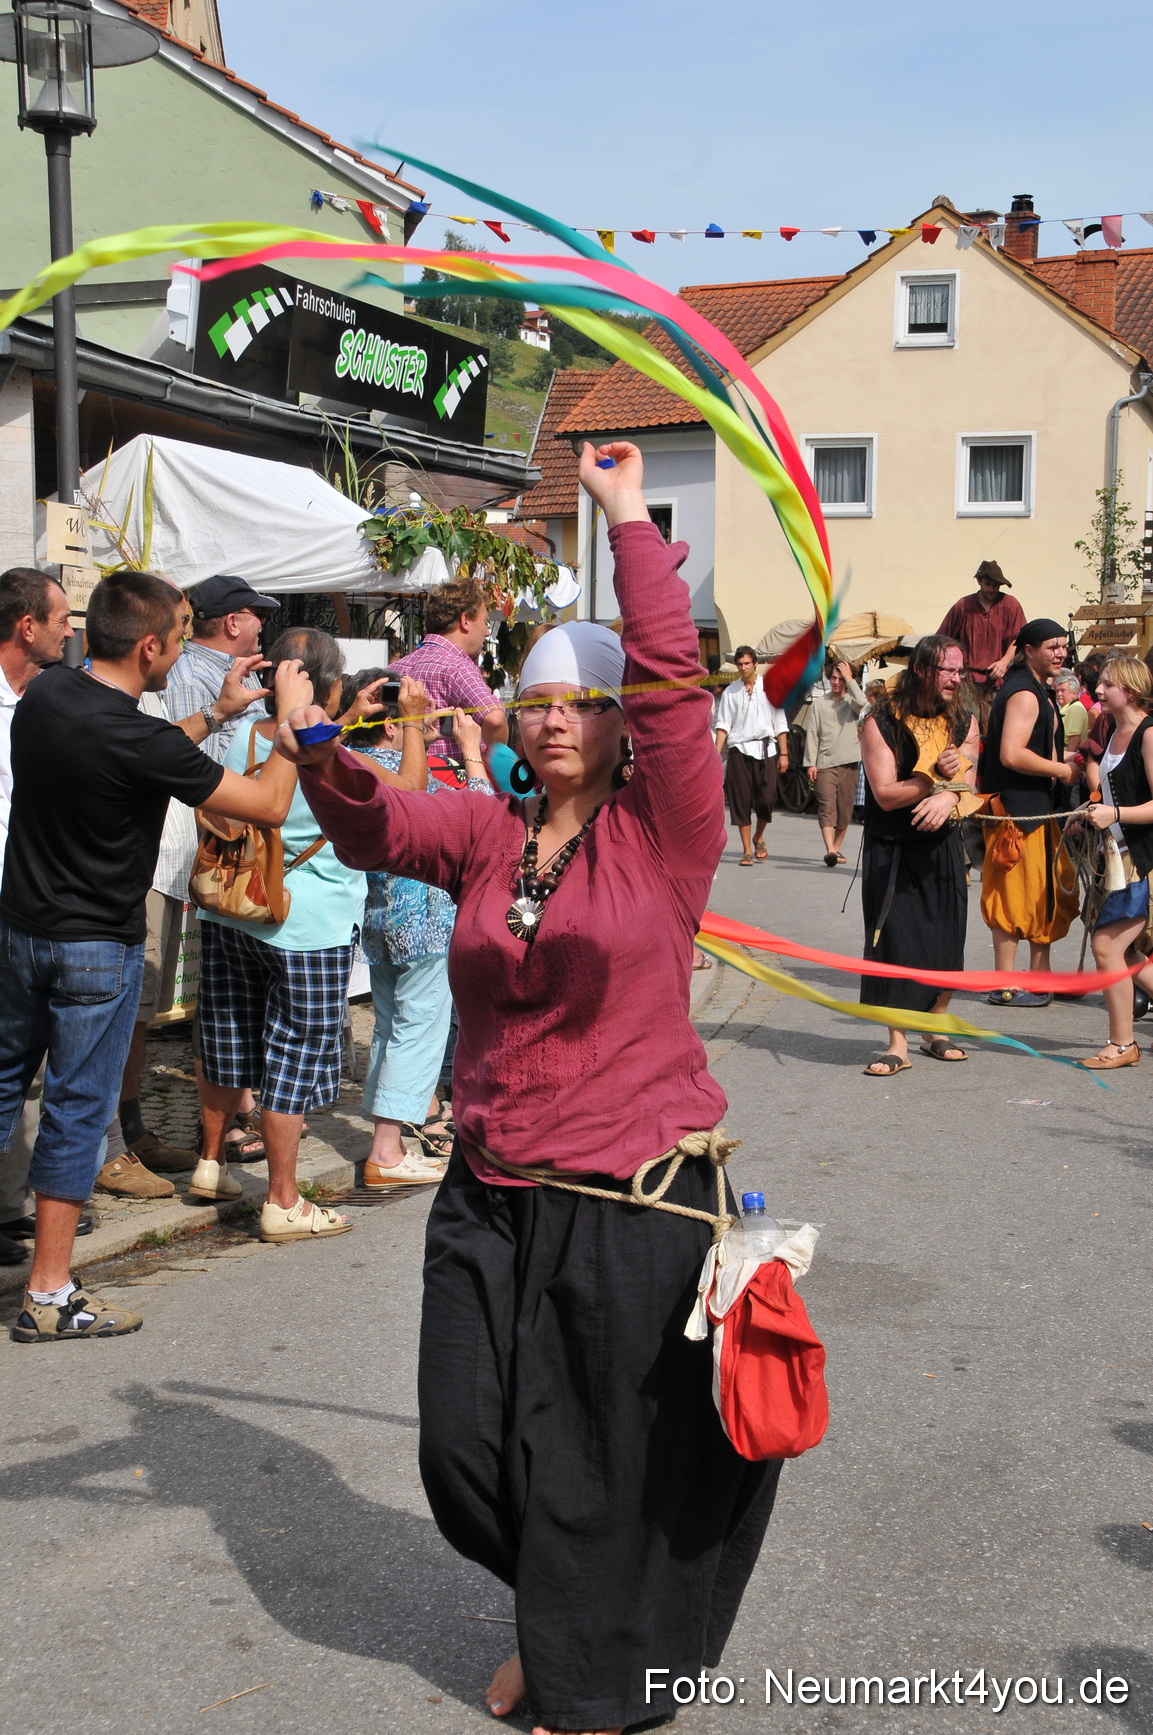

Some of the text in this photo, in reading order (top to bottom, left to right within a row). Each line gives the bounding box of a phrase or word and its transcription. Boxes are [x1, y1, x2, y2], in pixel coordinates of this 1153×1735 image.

[296, 284, 357, 326] Fahrschulen
[334, 328, 428, 400] SCHUSTER
[76, 594, 87, 605] WC
